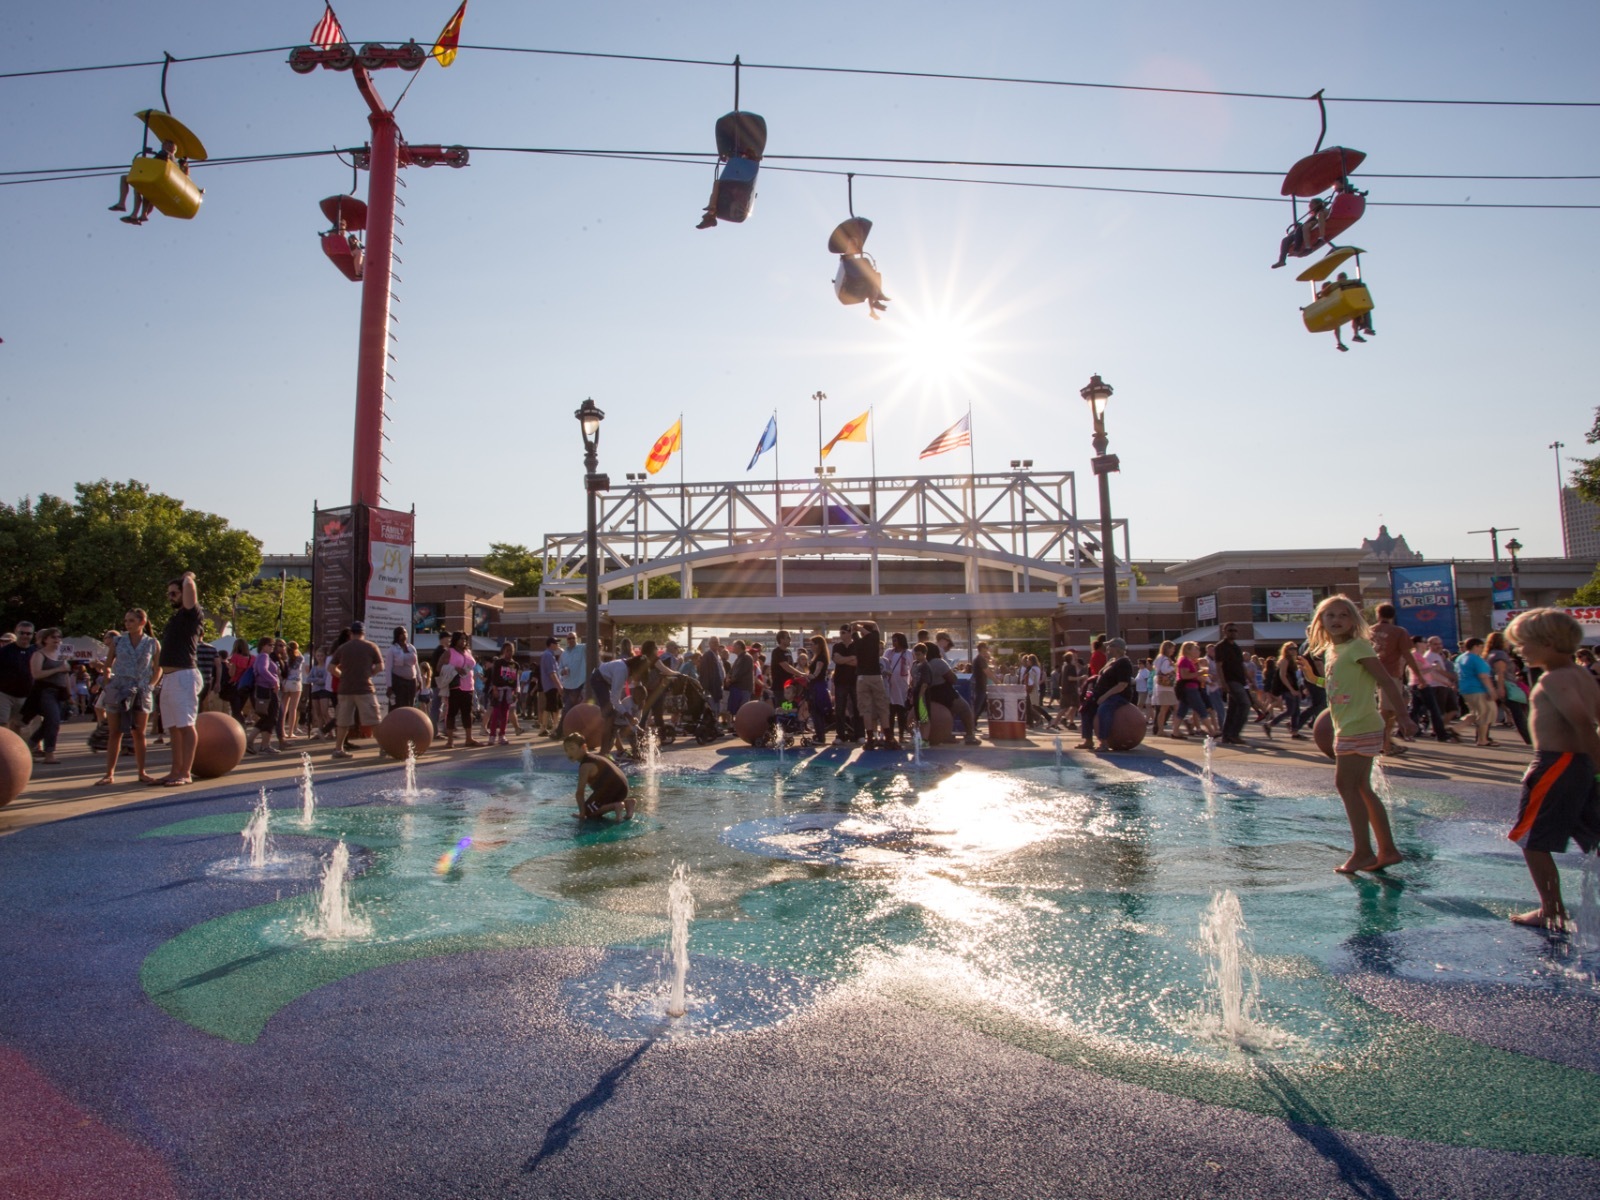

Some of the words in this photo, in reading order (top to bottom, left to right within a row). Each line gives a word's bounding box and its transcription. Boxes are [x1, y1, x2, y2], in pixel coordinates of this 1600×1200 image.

[381, 525, 405, 536] FAMILY
[1403, 579, 1442, 589] LOST
[1397, 586, 1449, 595] CHILDREN'S
[1401, 595, 1449, 607] AREA
